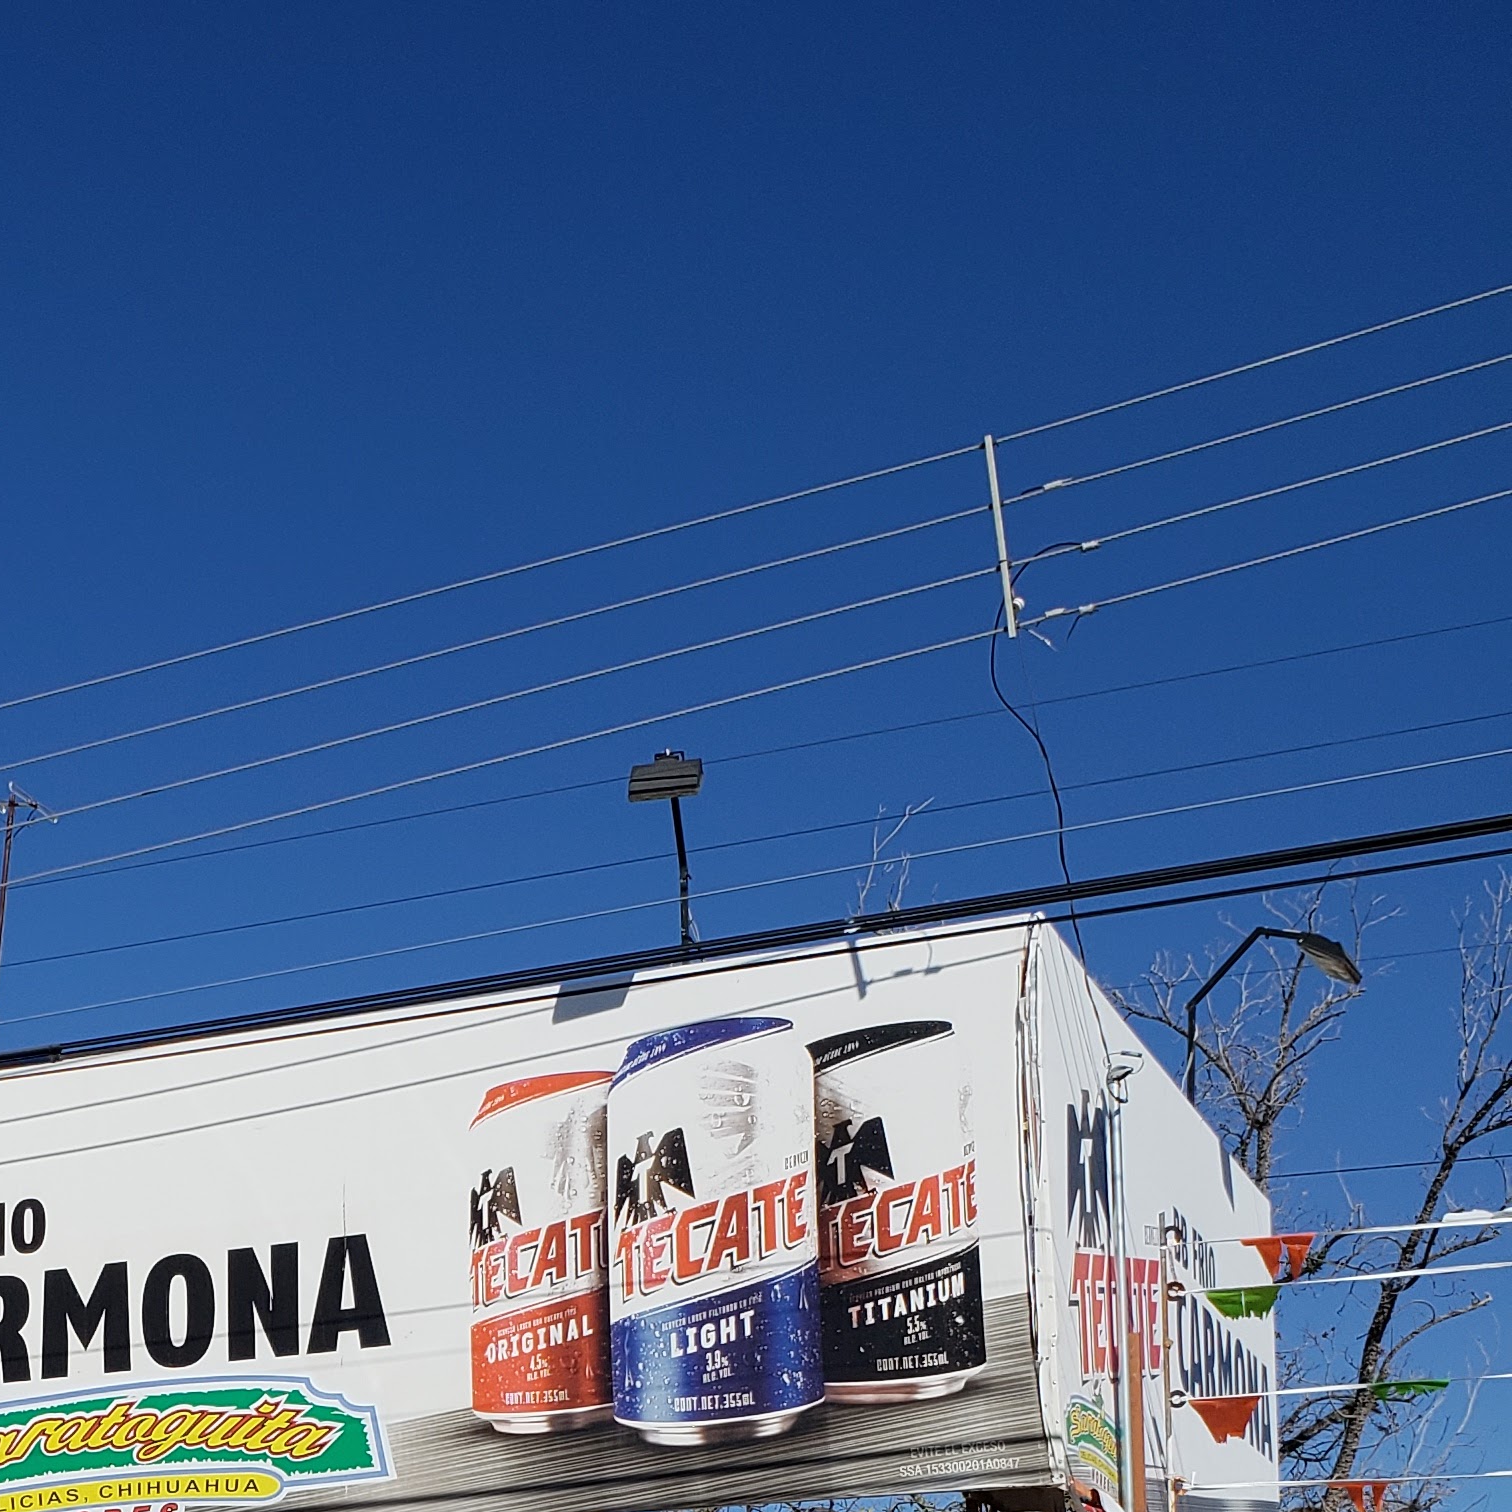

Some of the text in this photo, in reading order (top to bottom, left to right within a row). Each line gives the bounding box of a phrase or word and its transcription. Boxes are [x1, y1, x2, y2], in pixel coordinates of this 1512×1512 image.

[469, 1208, 608, 1314] TECAT
[613, 1170, 810, 1304] TECATE
[1191, 1226, 1216, 1290] FRIO
[848, 1271, 965, 1328] TITANIUM
[487, 1314, 594, 1364] ORIGINAL
[670, 1310, 755, 1358] LIGHT
[705, 1350, 729, 1371] 3.9%
[1176, 1290, 1274, 1463] CARMONA
[899, 1464, 923, 1477] SSA
[944, 1446, 959, 1456] EL
[961, 1440, 1006, 1453] EXCESO
[99, 1478, 261, 1501] CHIHUAHUA
